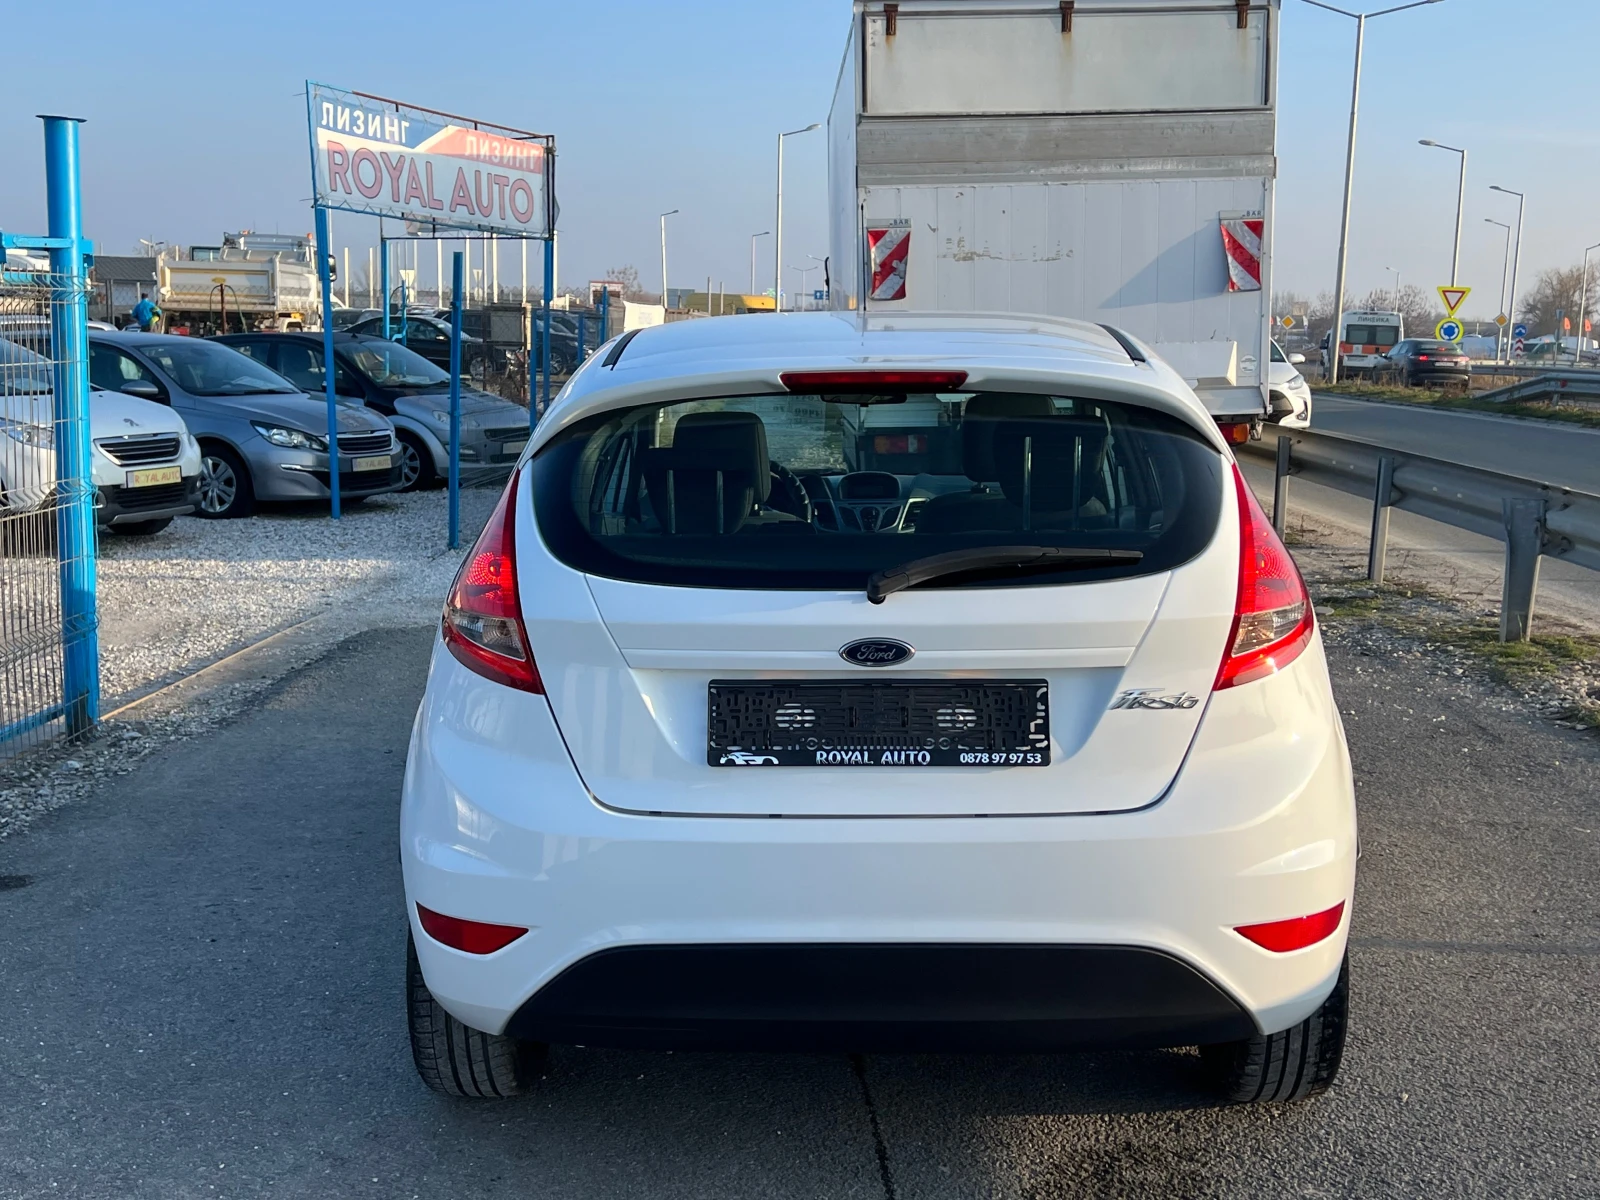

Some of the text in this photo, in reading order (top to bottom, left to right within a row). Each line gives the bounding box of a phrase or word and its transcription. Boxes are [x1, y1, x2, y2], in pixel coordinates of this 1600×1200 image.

[321, 101, 410, 144] ЛИЗИНГ
[464, 135, 541, 170] ЛИЗИНГ
[326, 139, 534, 224] ROYAL AUTO
[857, 644, 896, 660] Ford
[1107, 688, 1199, 710] Fiesta
[815, 750, 931, 765] ROYAL AUTO
[959, 752, 1042, 764] 0878 97 97 53
